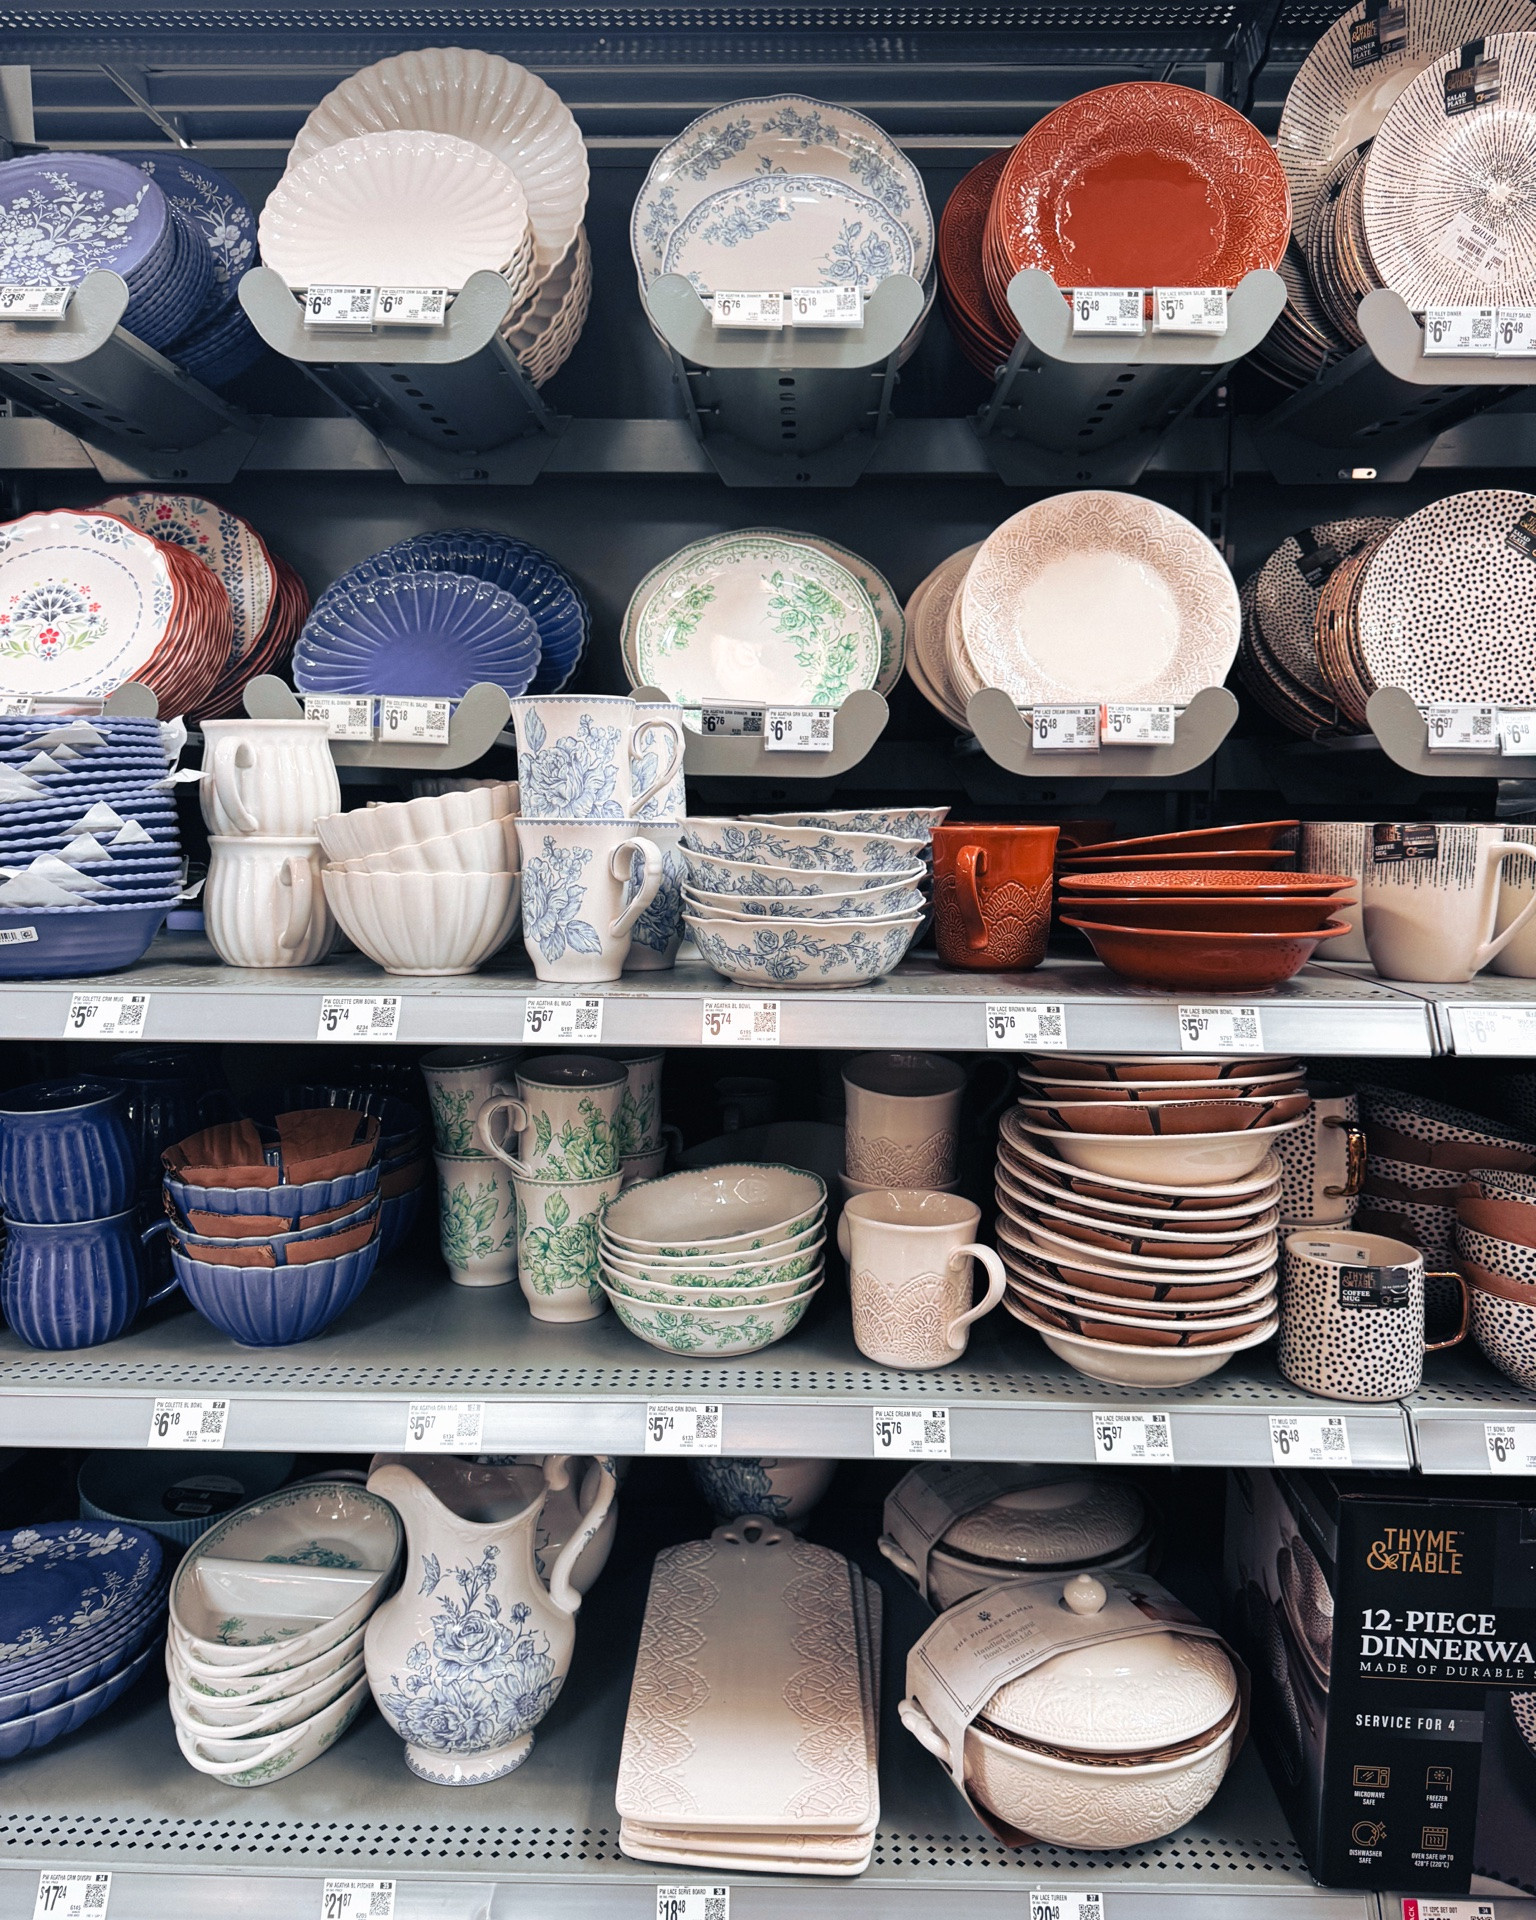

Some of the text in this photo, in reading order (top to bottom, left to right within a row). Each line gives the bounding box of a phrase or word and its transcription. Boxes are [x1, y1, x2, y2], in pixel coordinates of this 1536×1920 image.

[1352, 41, 1376, 55] DINNER
[1353, 49, 1371, 61] PLATE
[1446, 91, 1467, 103] SALAD
[1447, 98, 1466, 109] PLATE
[1471, 224, 1498, 246] 07/17/25
[1509, 534, 1528, 547] PLATE
[1513, 528, 1531, 543] SALAD
[1347, 1270, 1374, 1280] THYME
[1342, 1289, 1371, 1297] COFFEE
[1342, 1295, 1360, 1303] MUG
[1384, 1527, 1458, 1553] THYME
[1361, 1608, 1497, 1636] 12-PIECE
[953, 1604, 1034, 1652] THE PIONEER WOMAN
[1359, 1661, 1525, 1679] MADE OF DURABLE
[1355, 1713, 1456, 1732] SERVICE FOR 4
[1353, 1790, 1386, 1800] MICROWAVE
[1425, 1794, 1449, 1803] FREEZER
[1362, 1798, 1376, 1807] SAFE
[1429, 1801, 1443, 1810] SAFE
[1348, 1848, 1383, 1858] DISHWASHER
[1411, 1852, 1454, 1862] OVEN SAFE UP TO
[1358, 1856, 1372, 1865] SAFE
